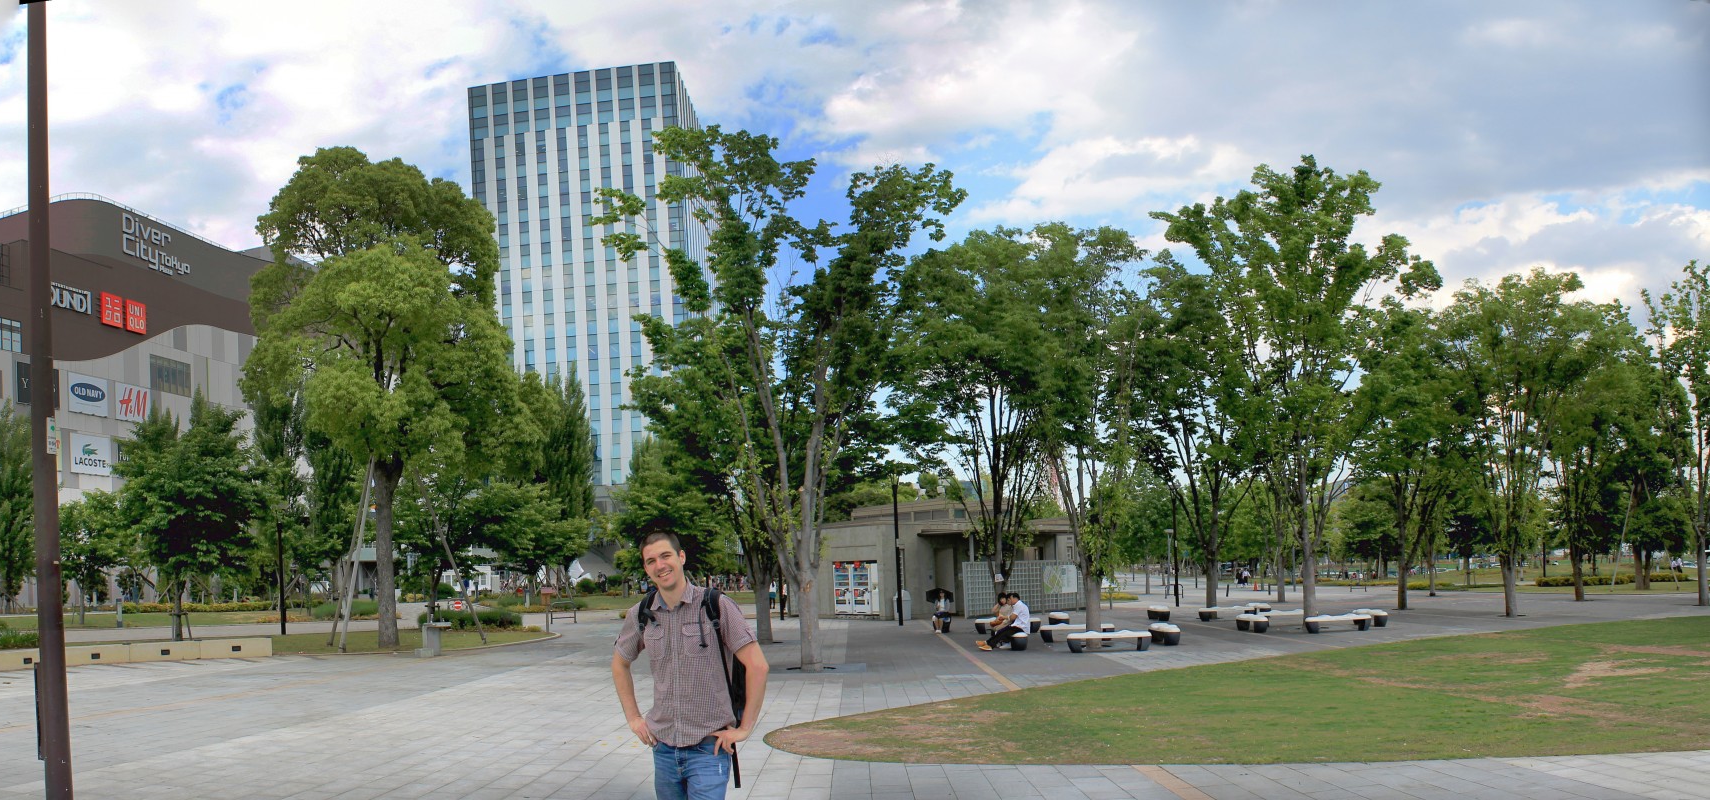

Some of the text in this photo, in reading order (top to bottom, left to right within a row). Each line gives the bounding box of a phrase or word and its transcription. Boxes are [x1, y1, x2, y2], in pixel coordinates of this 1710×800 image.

[122, 212, 171, 247] Diver
[122, 233, 191, 275] City Tokyo
[129, 303, 143, 318] UNI
[129, 316, 145, 330] QLO
[74, 386, 103, 399] OLD NAVY
[119, 386, 148, 420] H&M
[74, 456, 106, 468] LACOSTE
